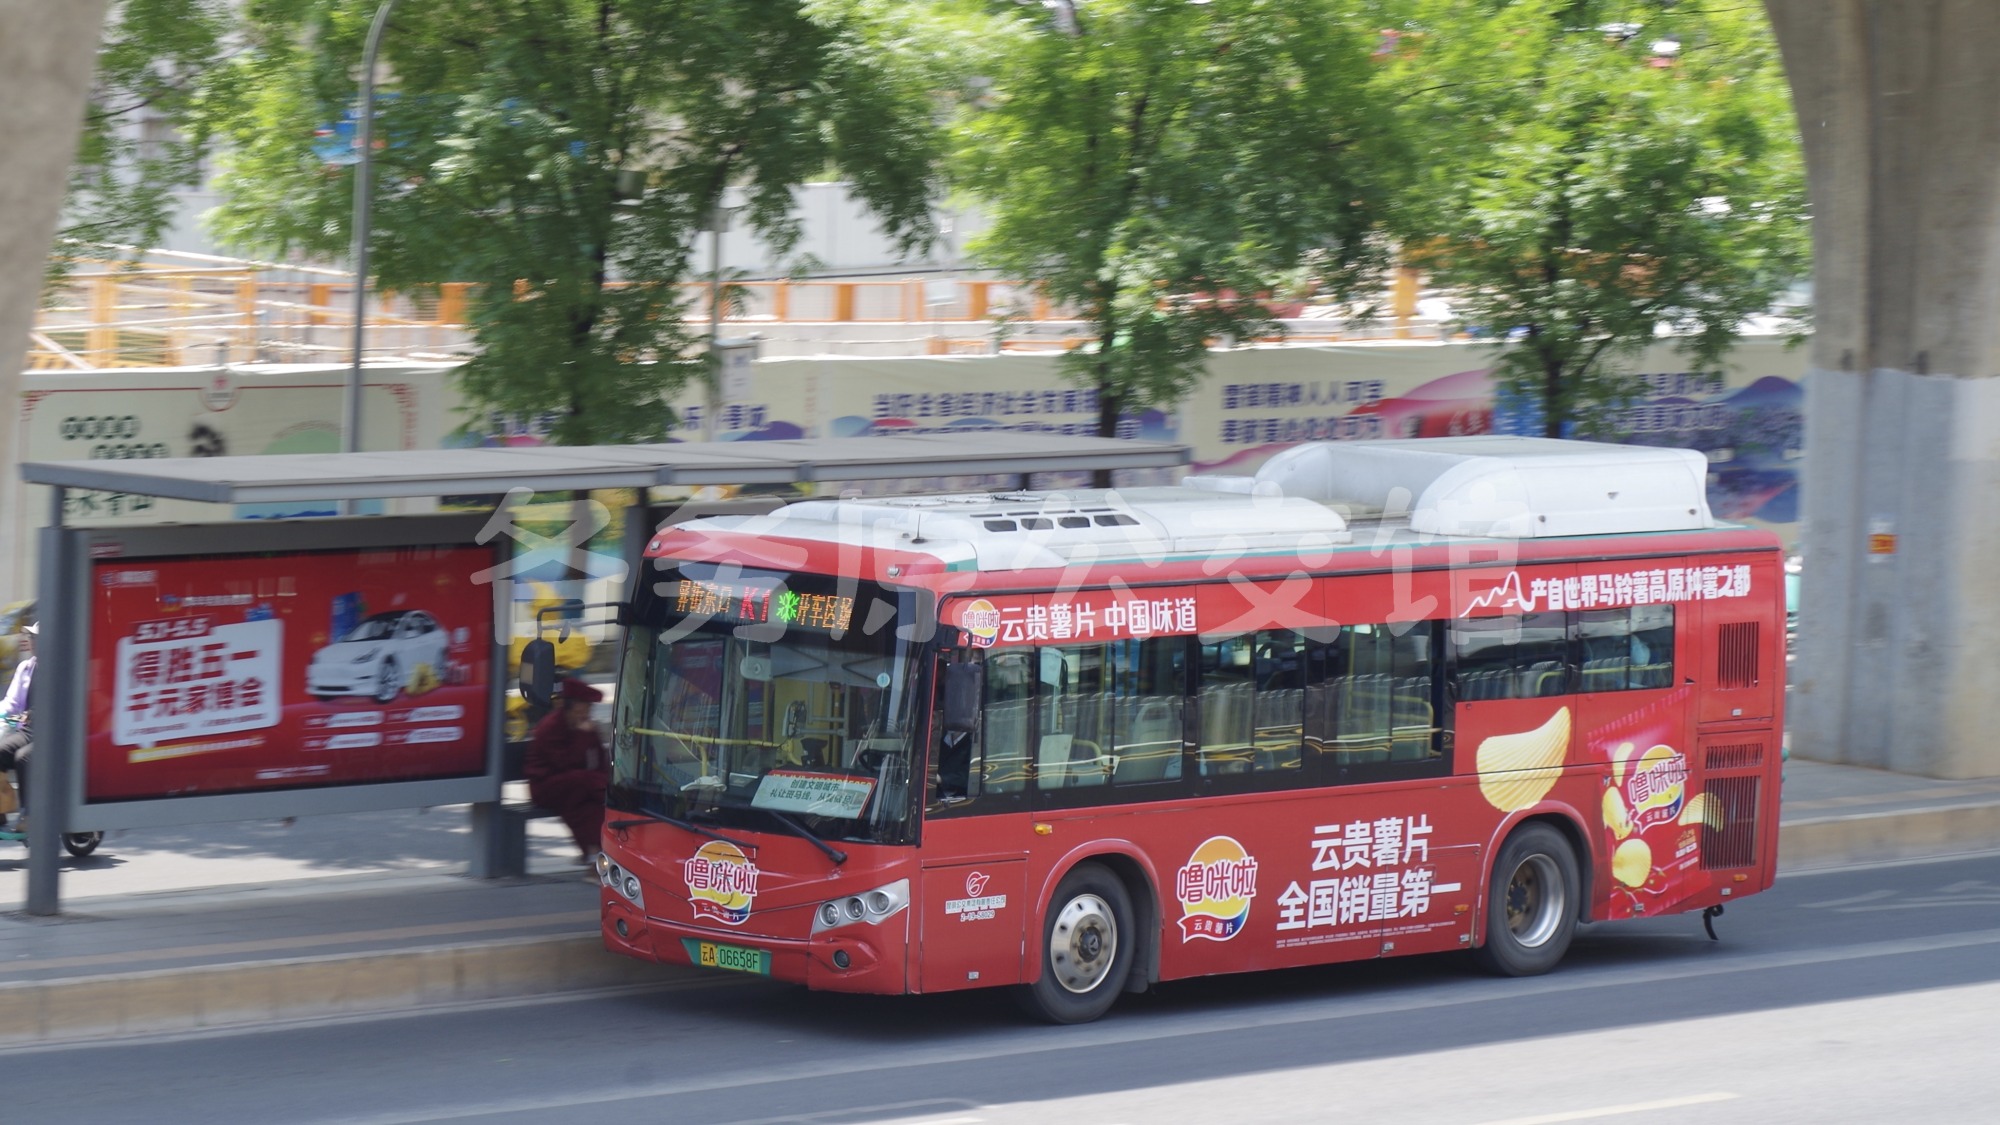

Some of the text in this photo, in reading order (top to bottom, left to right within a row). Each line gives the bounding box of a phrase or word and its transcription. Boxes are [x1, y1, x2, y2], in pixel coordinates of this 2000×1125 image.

[739, 586, 772, 622] K1
[1531, 565, 1751, 610] 产自世界马铃薯高原种薯之都
[1000, 597, 1197, 642] 云贵薯片 中国味道
[790, 779, 840, 792] 创建文明城市
[1628, 752, 1688, 804] 噜咪啦
[1311, 814, 1433, 872] 云贵薯片
[685, 857, 759, 897] 噜咪啦
[1177, 856, 1258, 904] 噜咪啦
[1276, 868, 1461, 931] 全国销量第一
[1194, 919, 1234, 935] 云贵薯片
